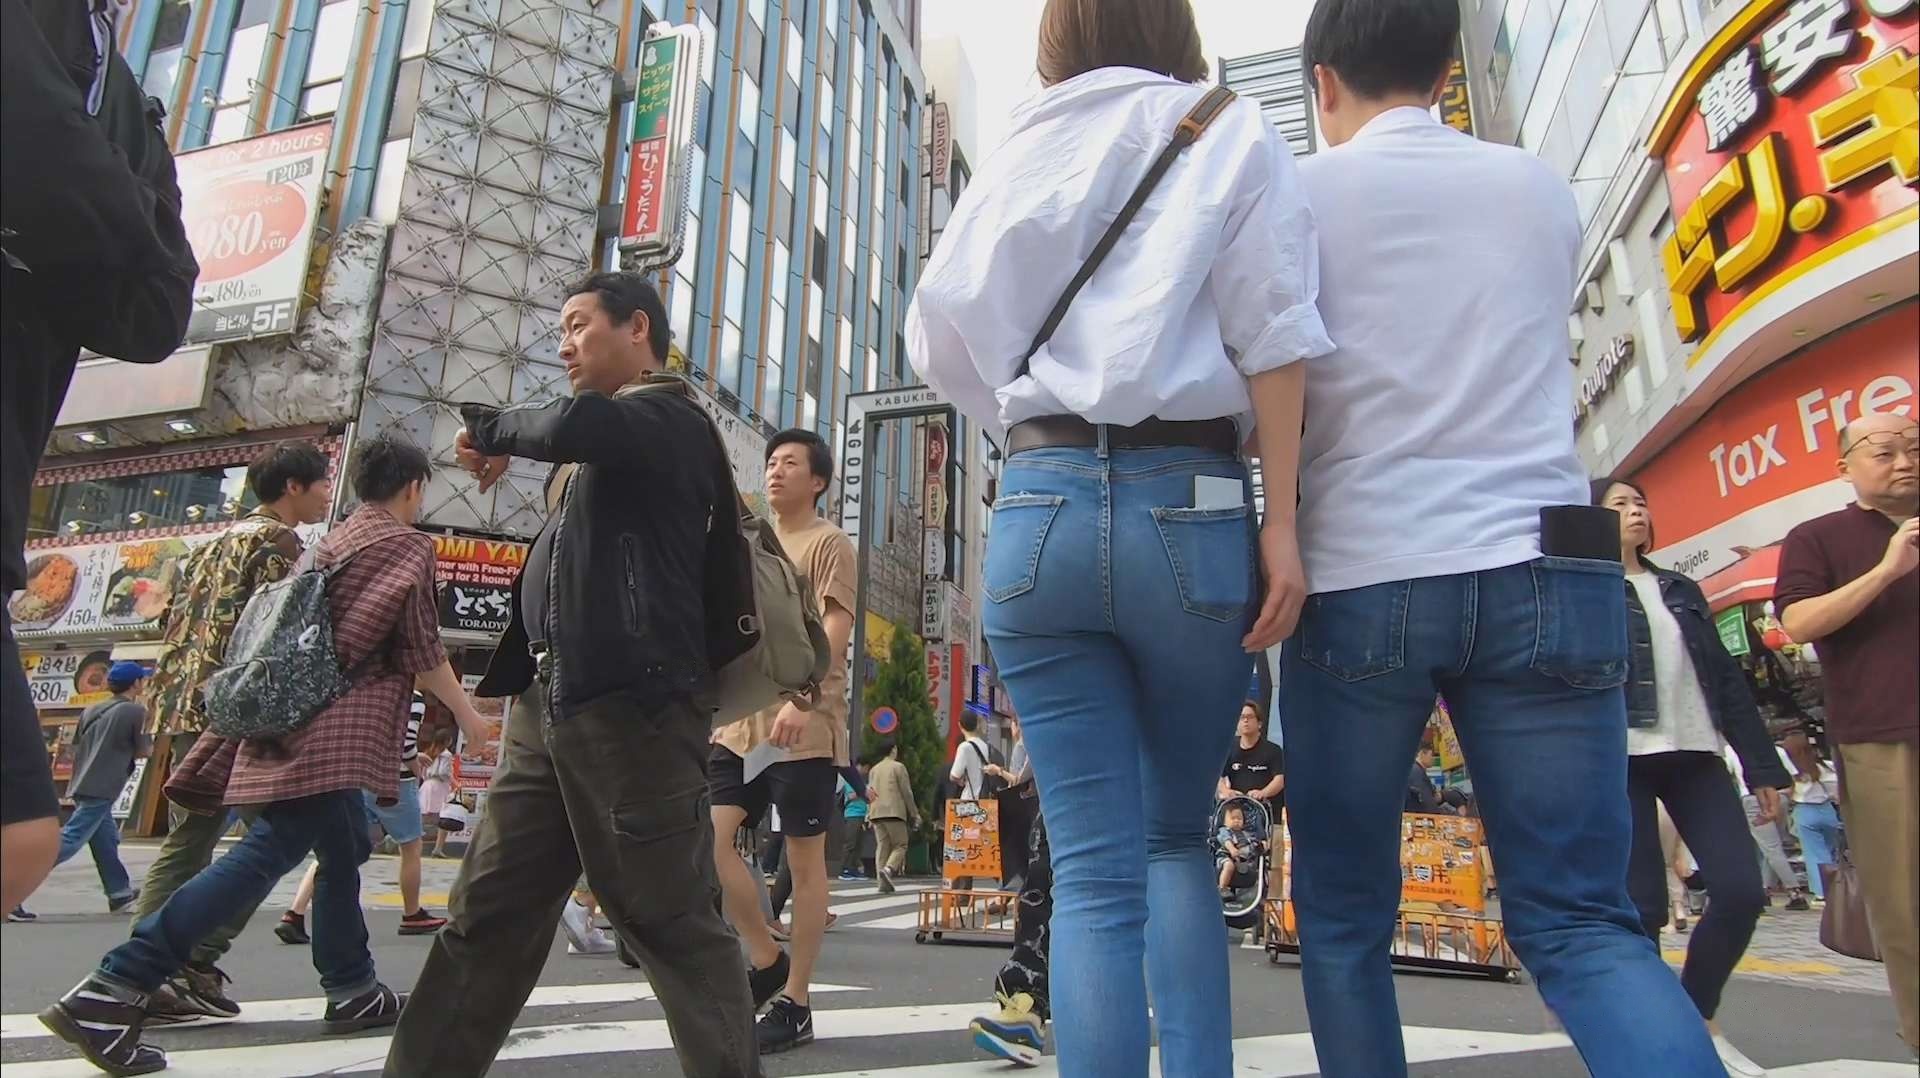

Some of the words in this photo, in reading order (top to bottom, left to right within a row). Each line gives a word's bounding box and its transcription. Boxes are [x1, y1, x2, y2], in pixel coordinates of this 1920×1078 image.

[269, 131, 324, 154] hours
[636, 152, 659, 232] ひょうたん
[252, 303, 291, 332] 5F
[1581, 334, 1631, 404] Quijote
[1709, 424, 1787, 498] Tax
[455, 573, 471, 583] for
[472, 574, 480, 584] 2
[481, 575, 511, 585] hours
[458, 562, 480, 573] with
